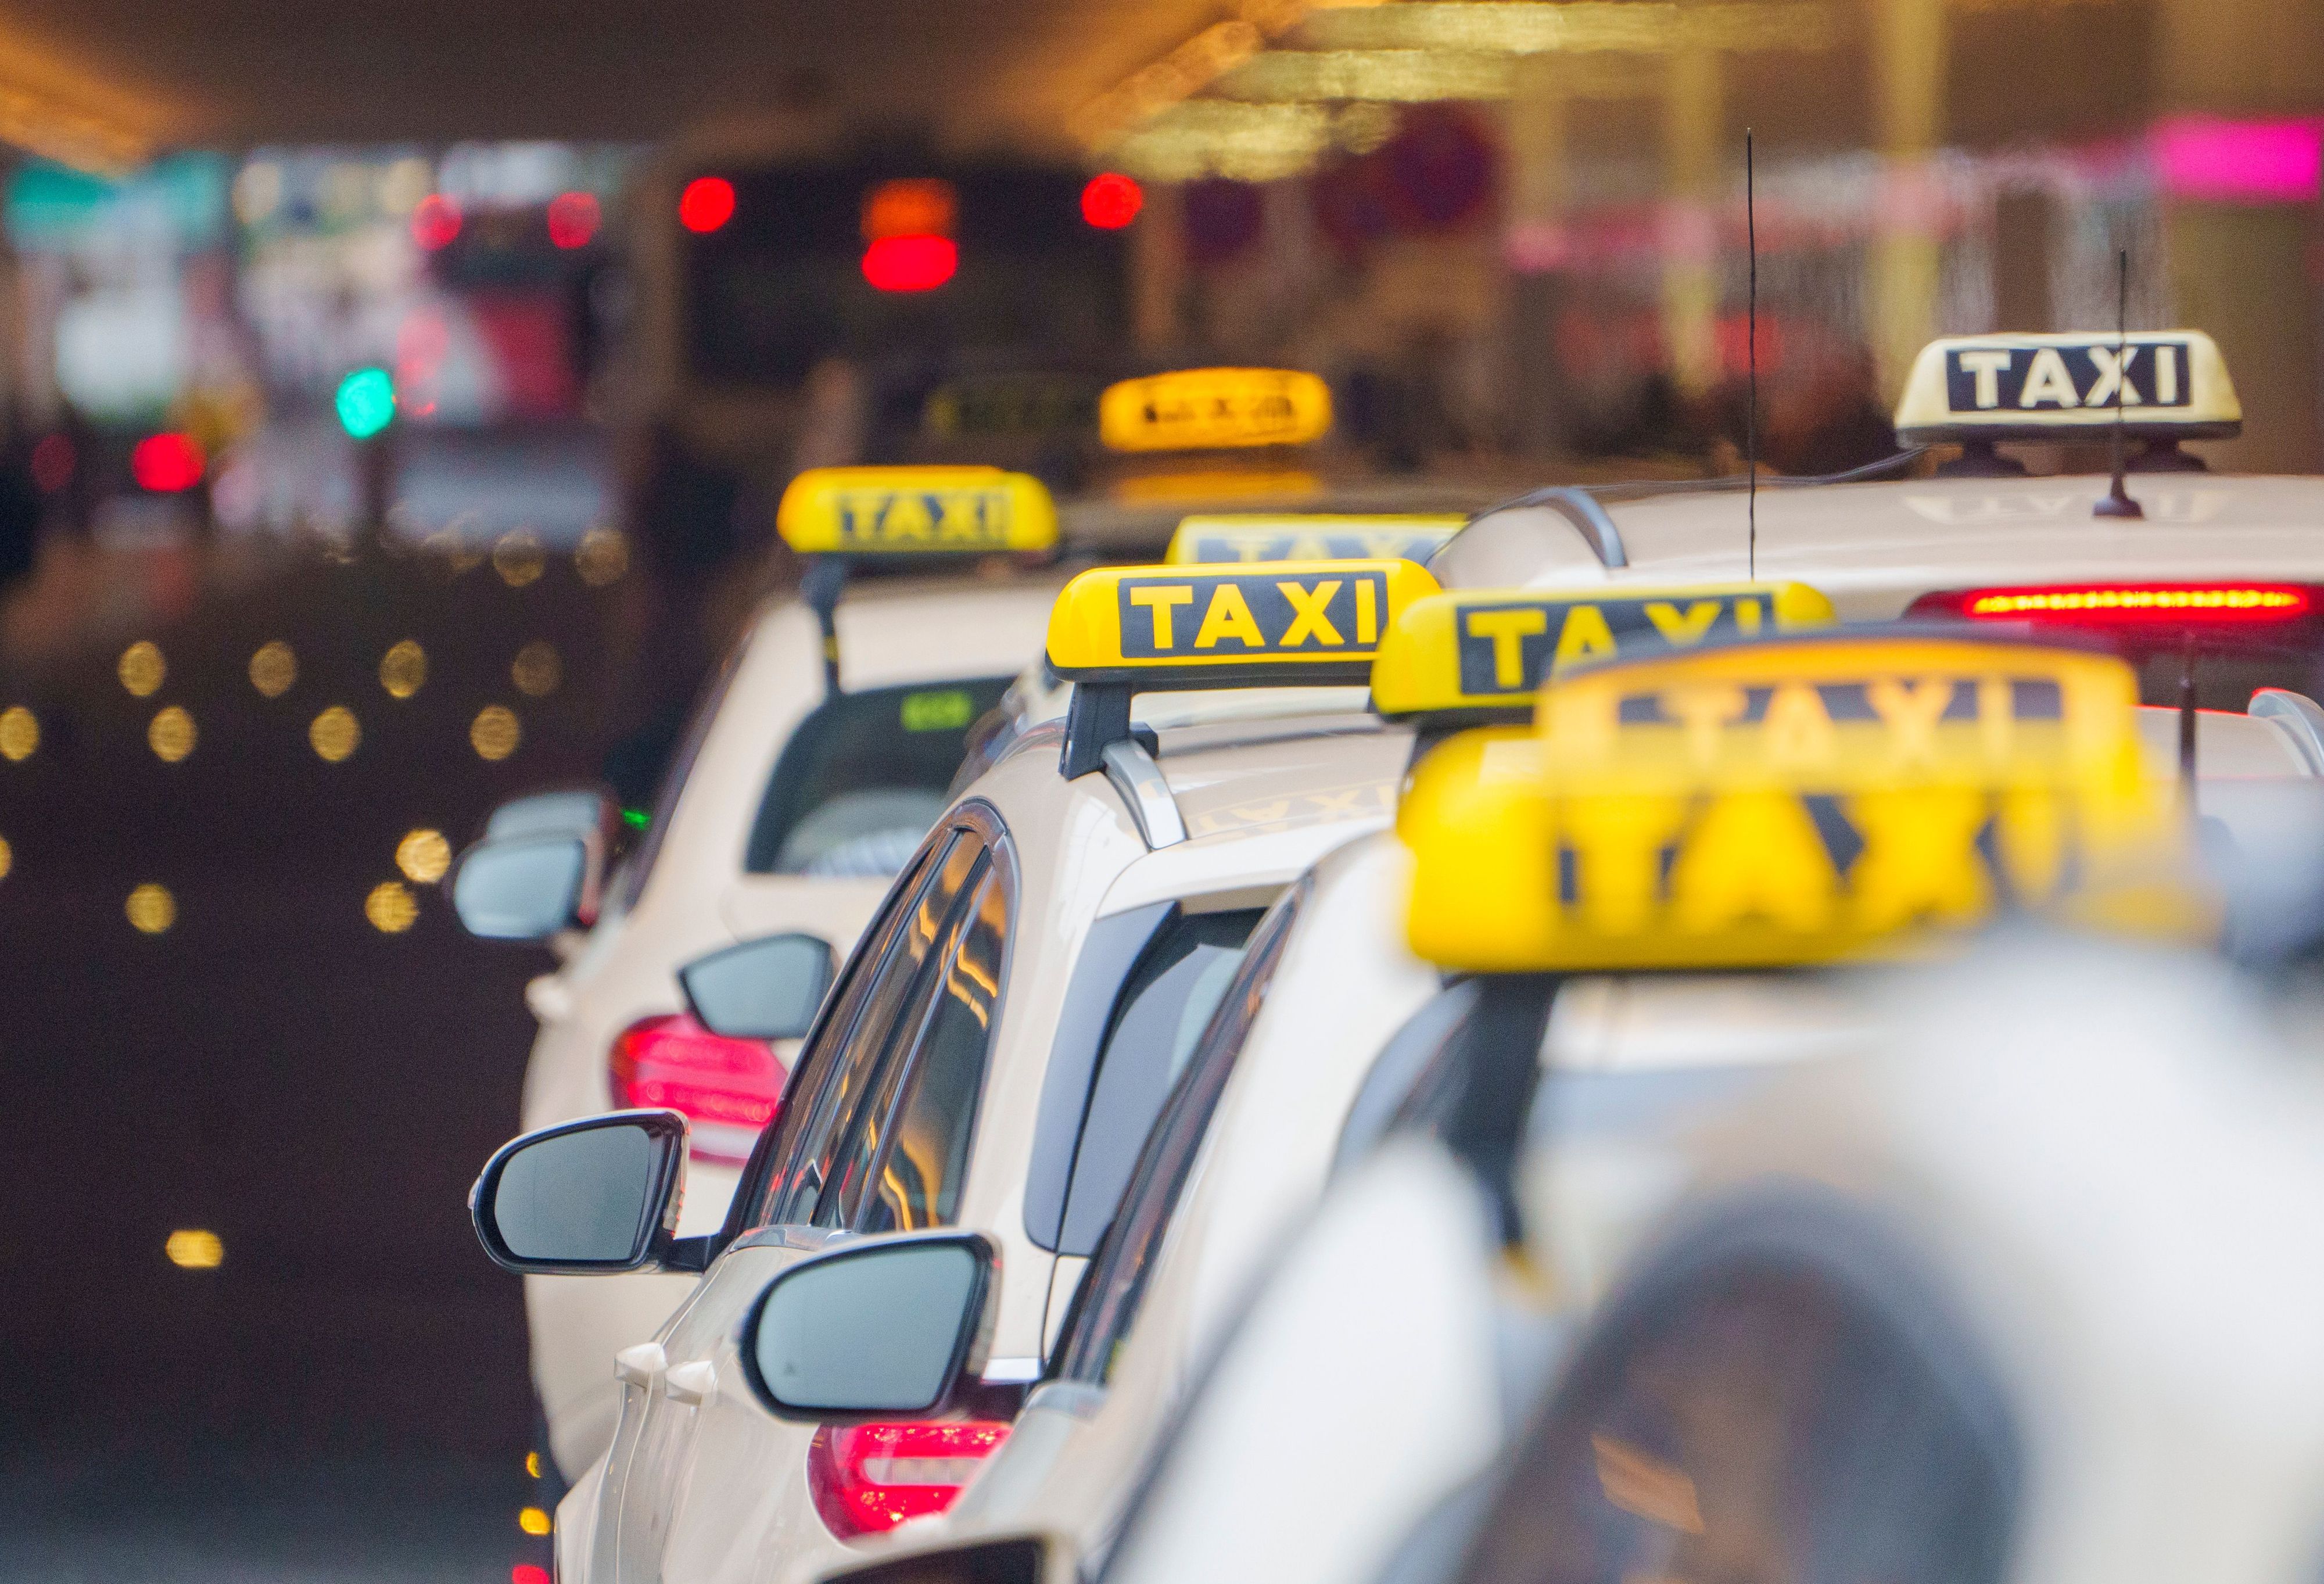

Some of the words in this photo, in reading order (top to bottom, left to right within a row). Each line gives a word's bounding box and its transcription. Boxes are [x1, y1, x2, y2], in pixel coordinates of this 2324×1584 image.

[1959, 346, 2178, 408] TAXI
[1129, 579, 1377, 649] TAXI
[1656, 680, 2013, 771] TAXI
